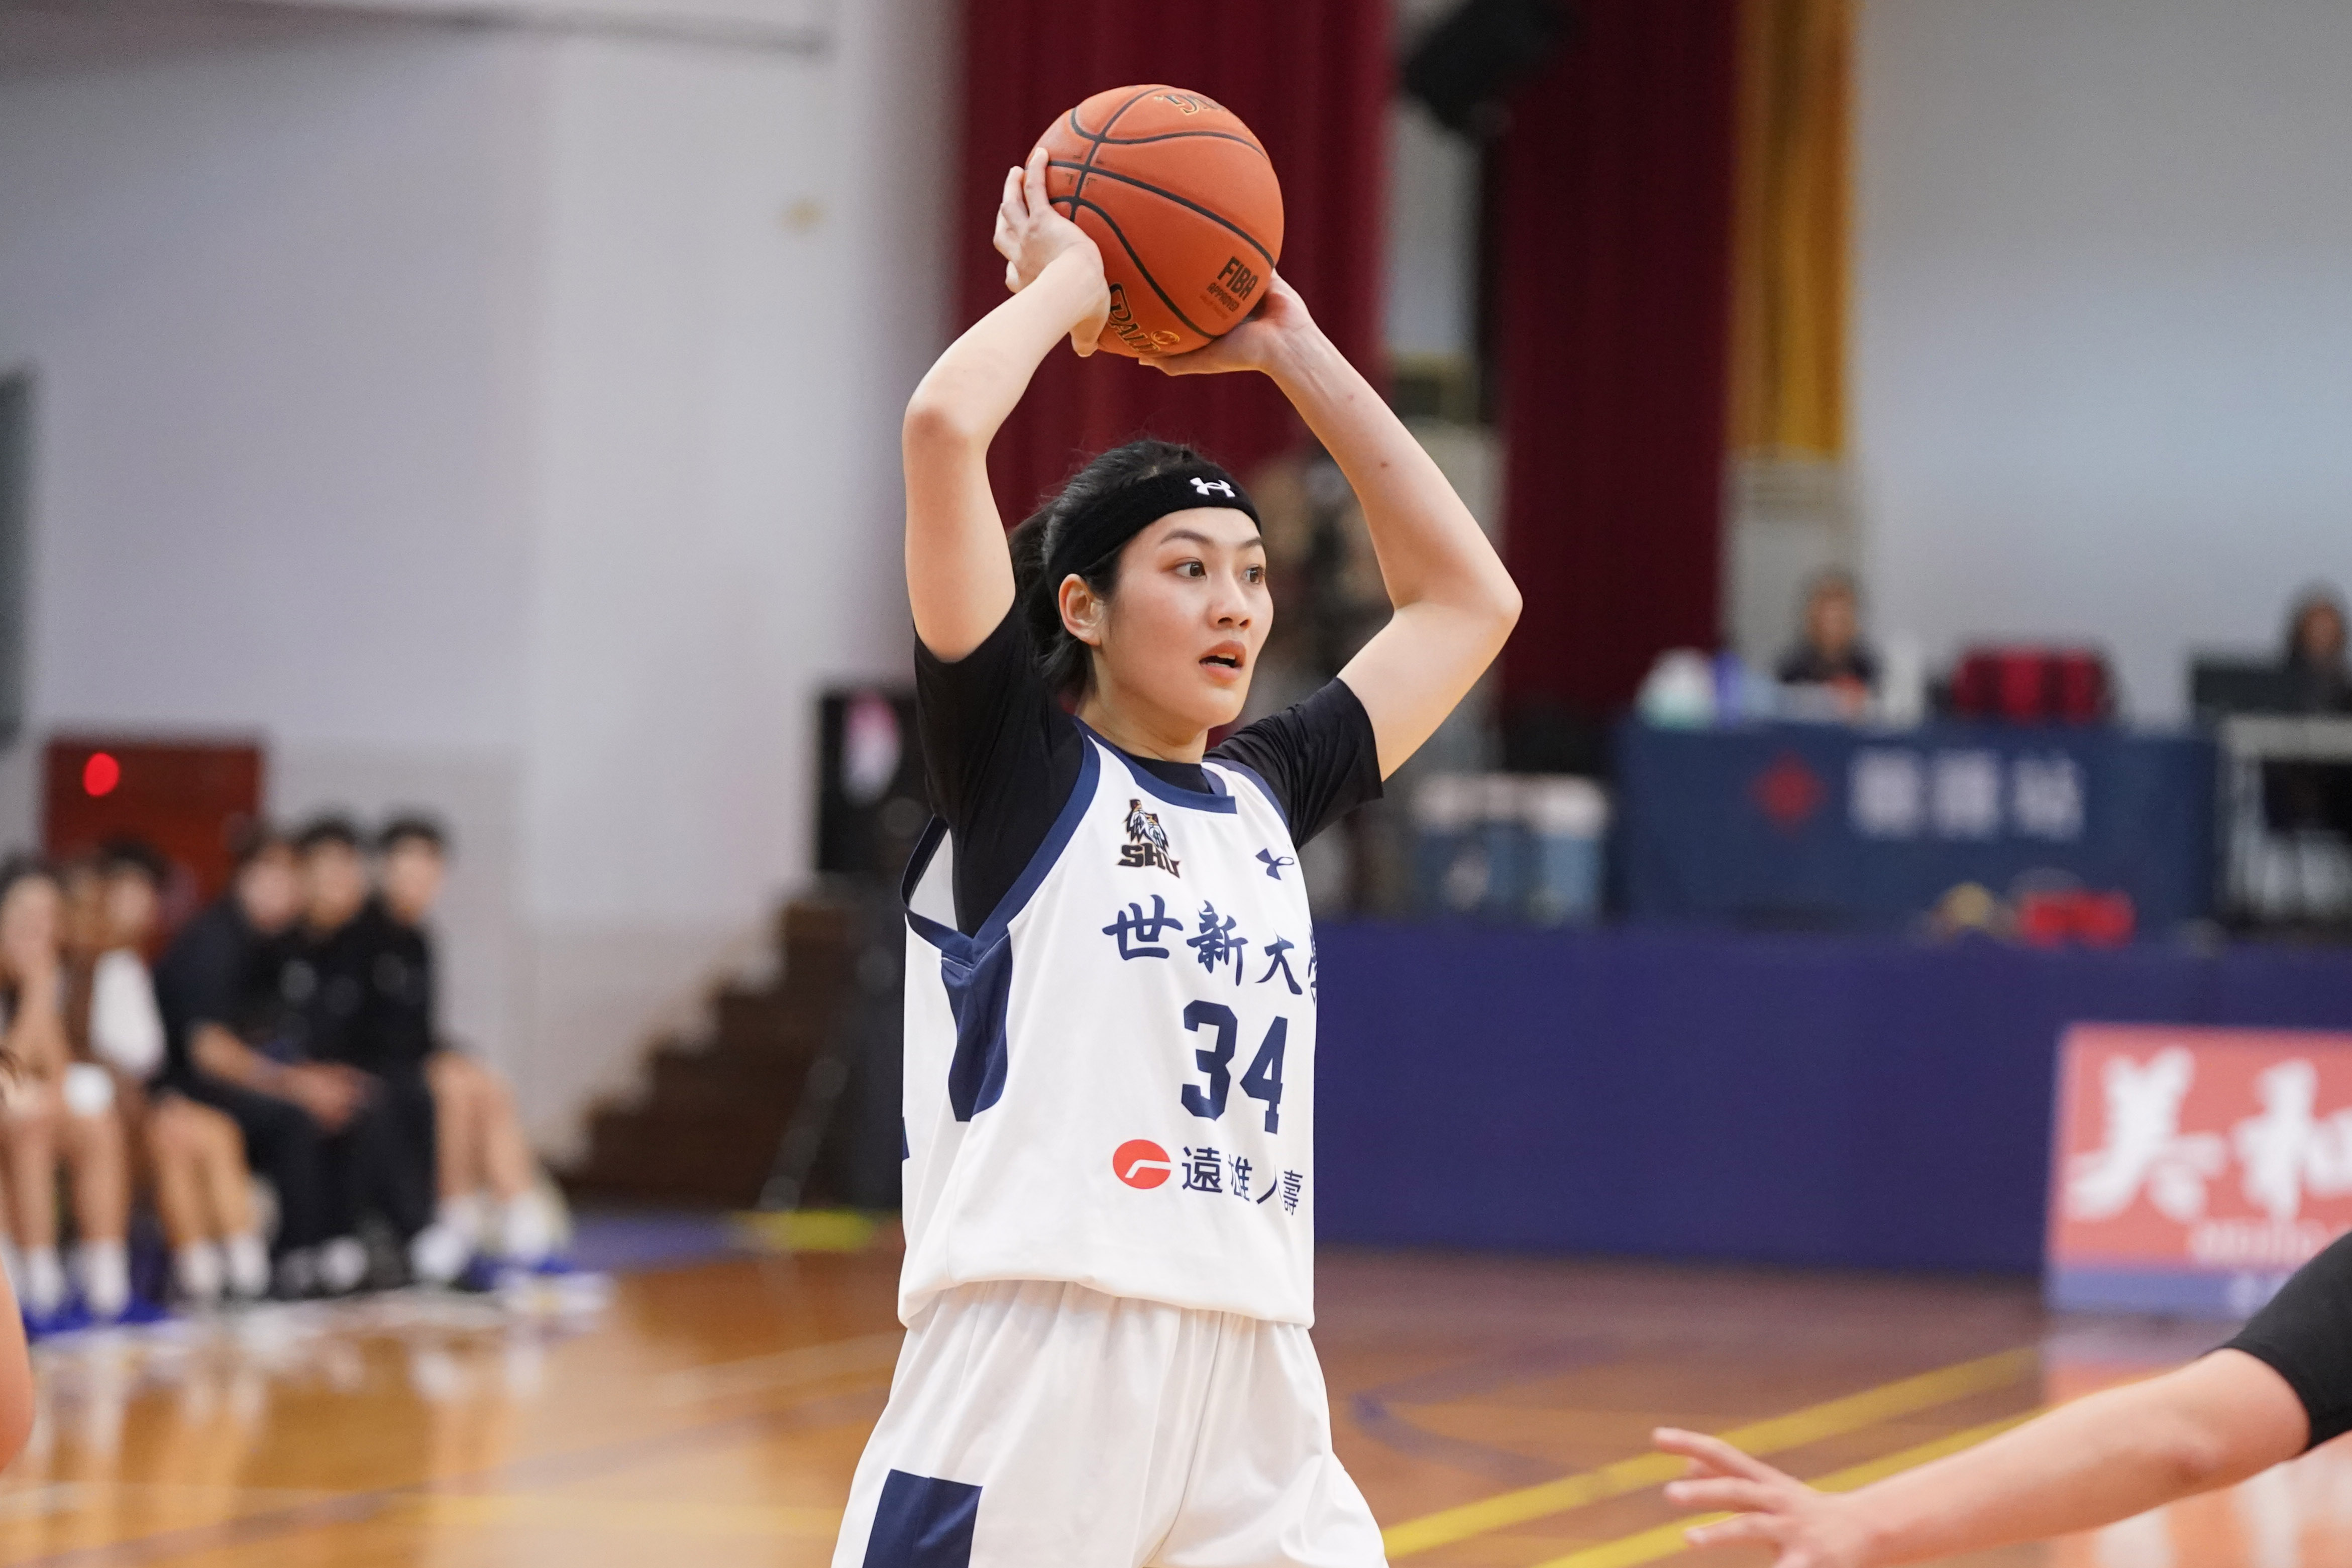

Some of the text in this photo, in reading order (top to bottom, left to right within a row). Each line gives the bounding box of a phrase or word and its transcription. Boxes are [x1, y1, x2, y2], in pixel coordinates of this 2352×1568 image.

[1217, 256, 1258, 301] FIBA
[1116, 842, 1181, 879] SHU
[1181, 999, 1288, 1136] 34
